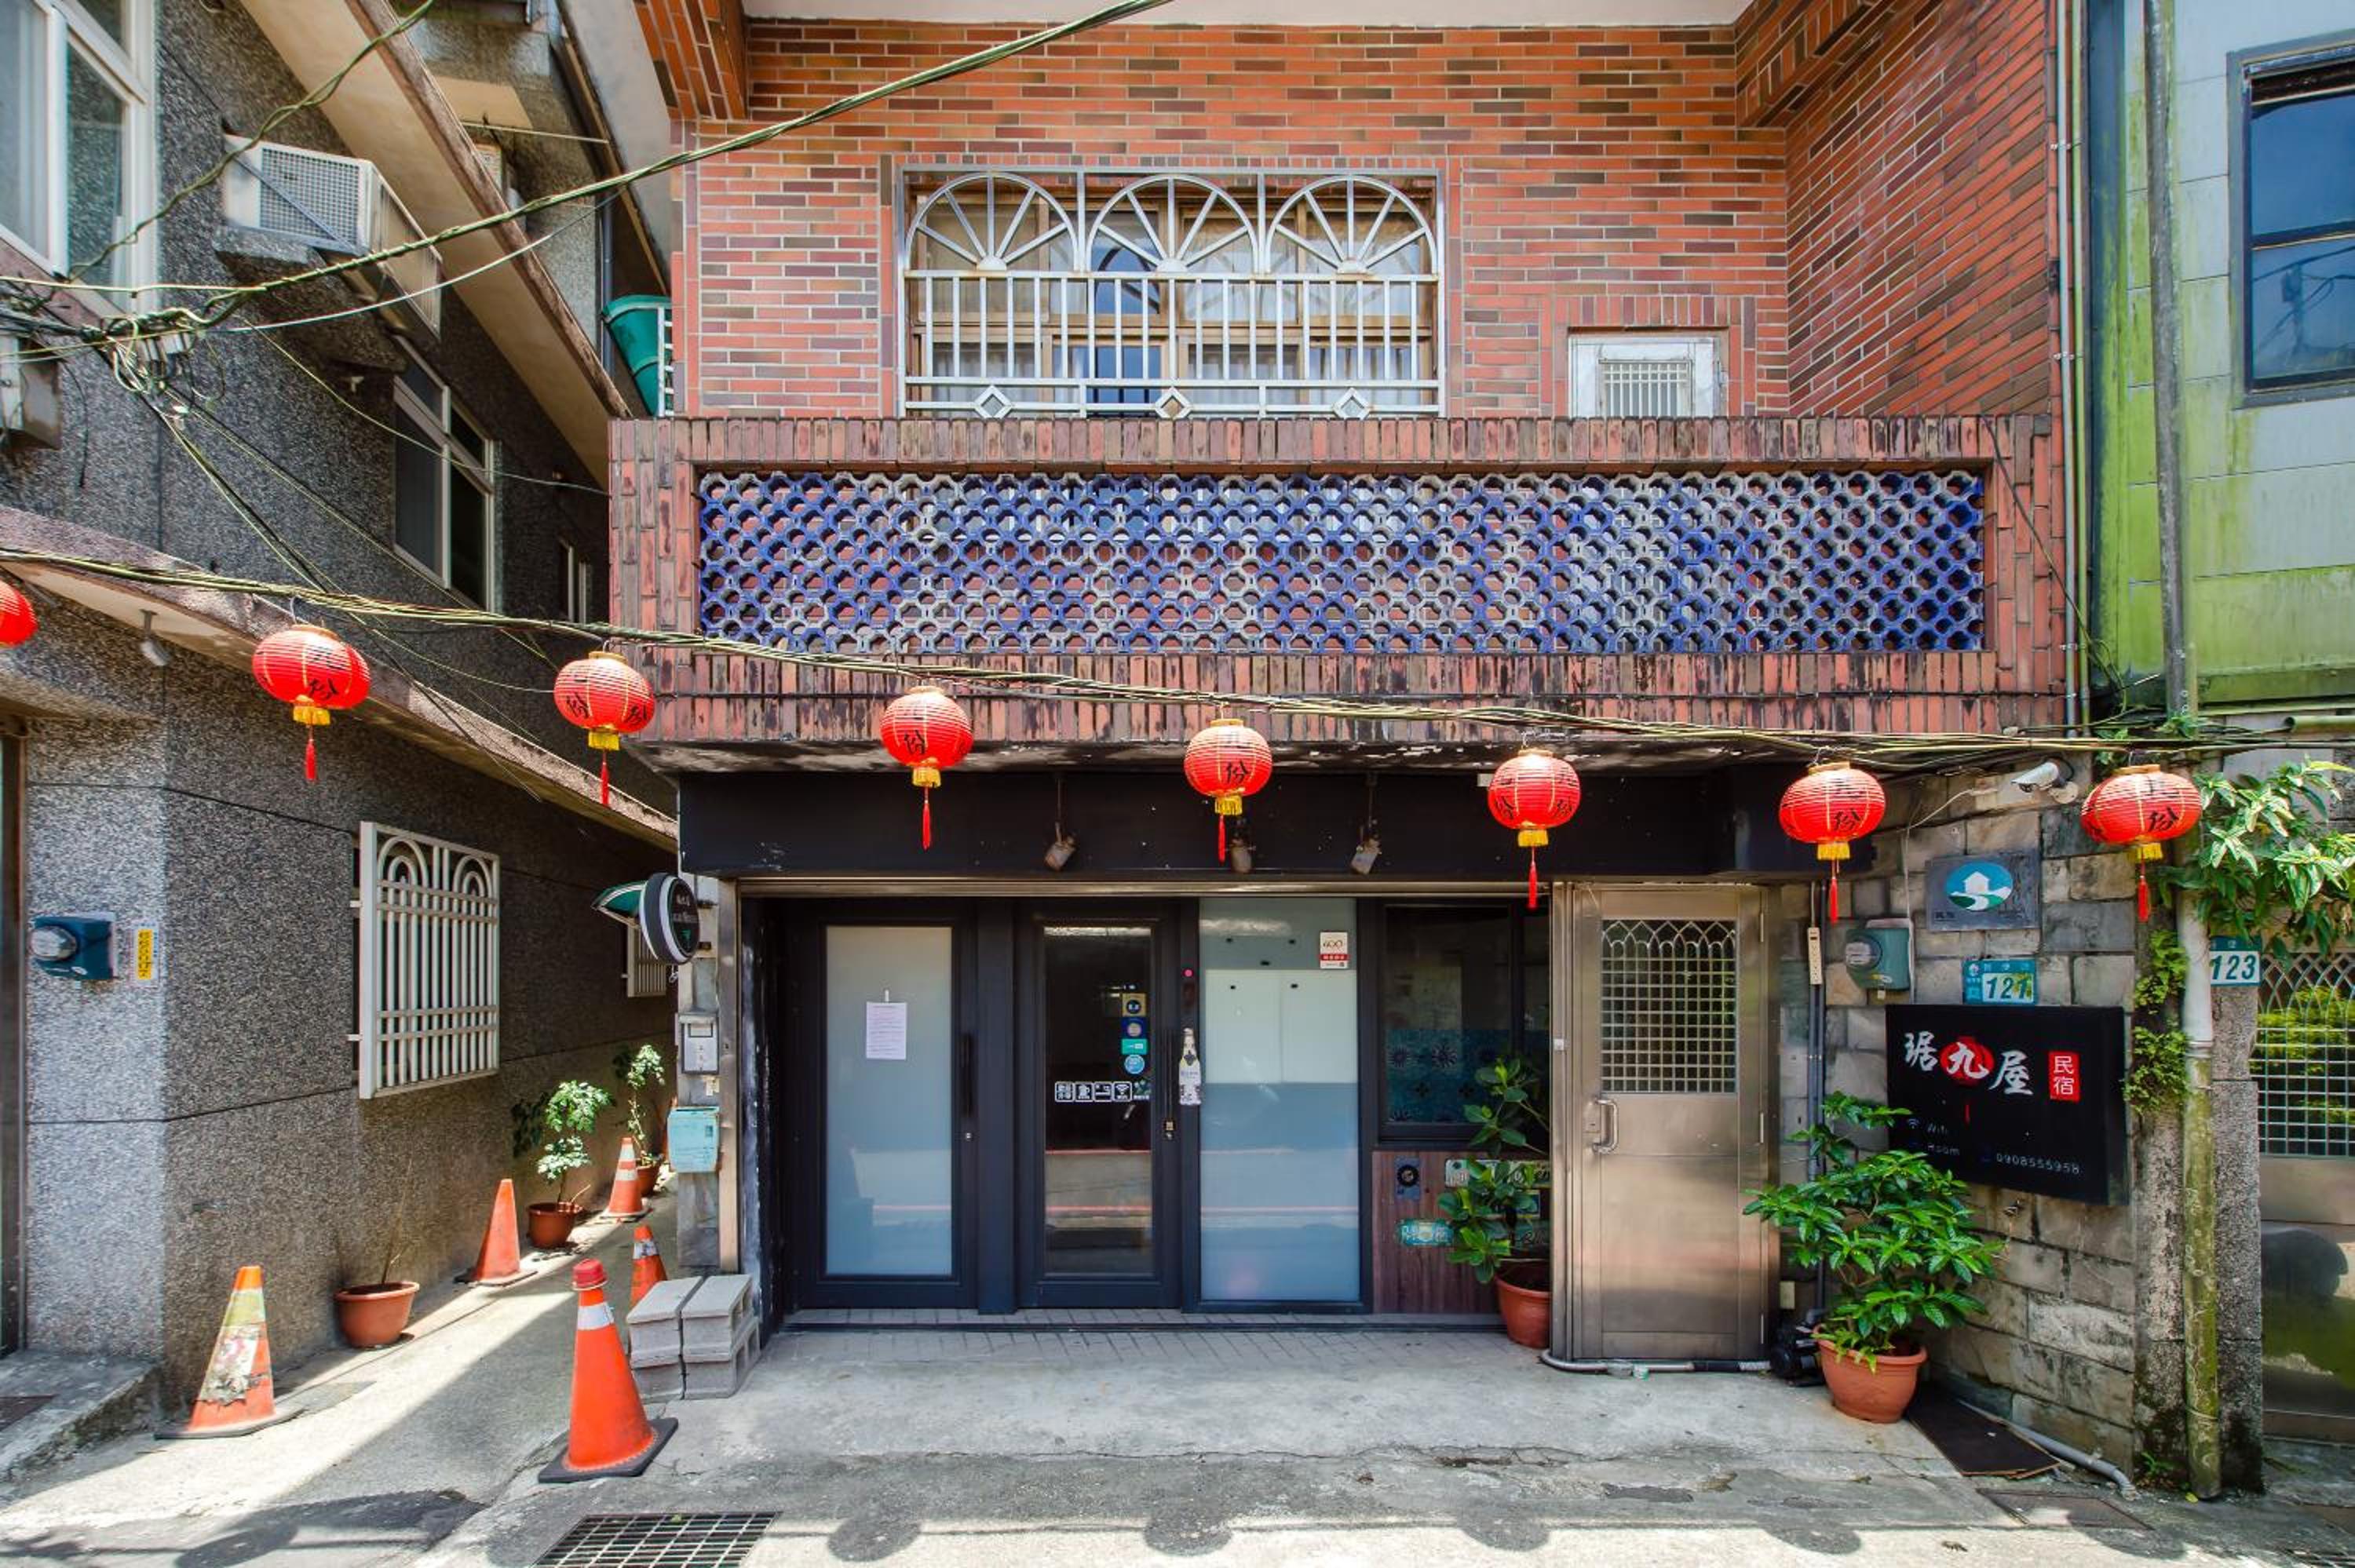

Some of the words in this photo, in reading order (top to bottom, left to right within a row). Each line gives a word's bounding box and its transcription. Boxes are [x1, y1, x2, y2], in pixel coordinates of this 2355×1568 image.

[2210, 954, 2257, 980] 123
[1985, 977, 2028, 999] 121
[2054, 1056, 2075, 1095] 民宿
[1995, 1151, 2081, 1176] 0908555958
